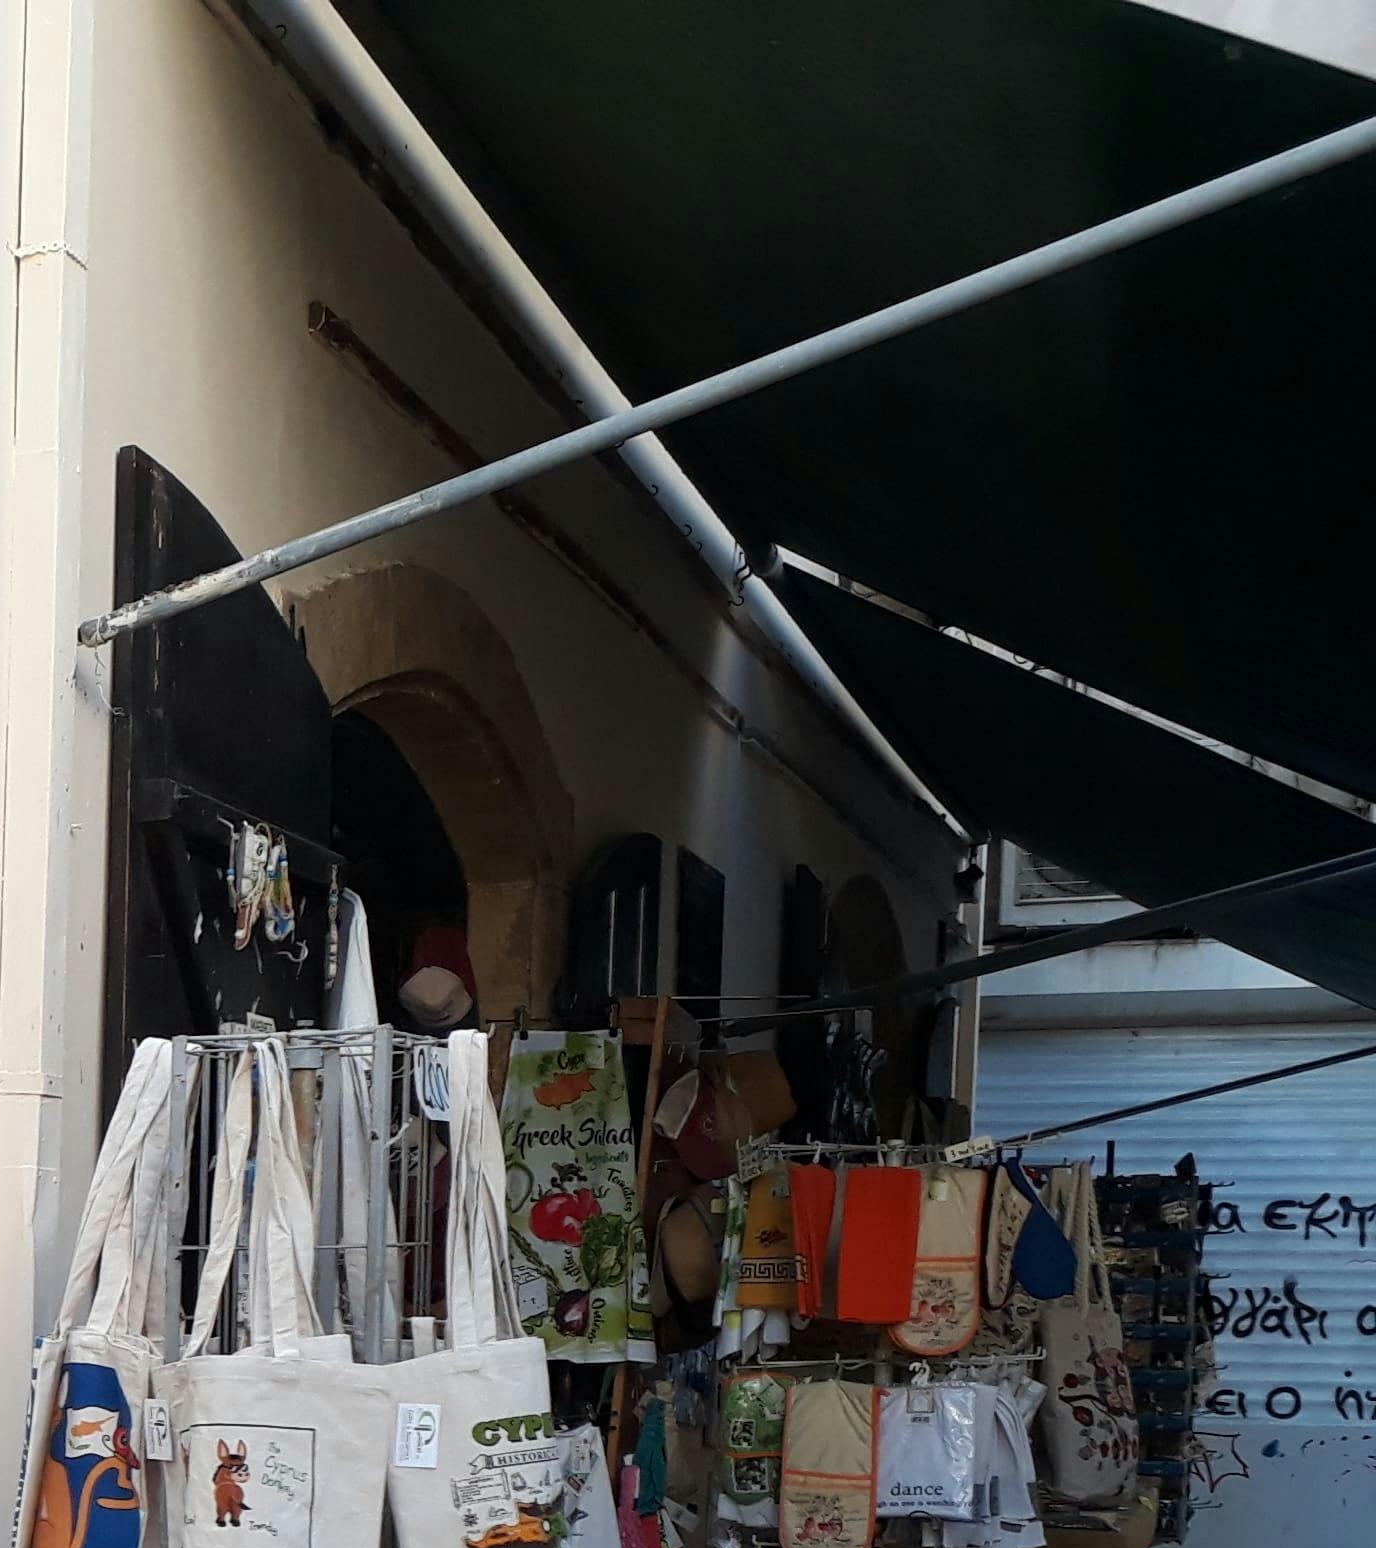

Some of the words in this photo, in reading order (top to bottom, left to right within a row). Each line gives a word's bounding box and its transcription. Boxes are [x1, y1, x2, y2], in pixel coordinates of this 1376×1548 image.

[512, 1121, 576, 1160] Greek
[264, 1455, 309, 1483] Cyprus
[890, 1481, 944, 1497] dance
